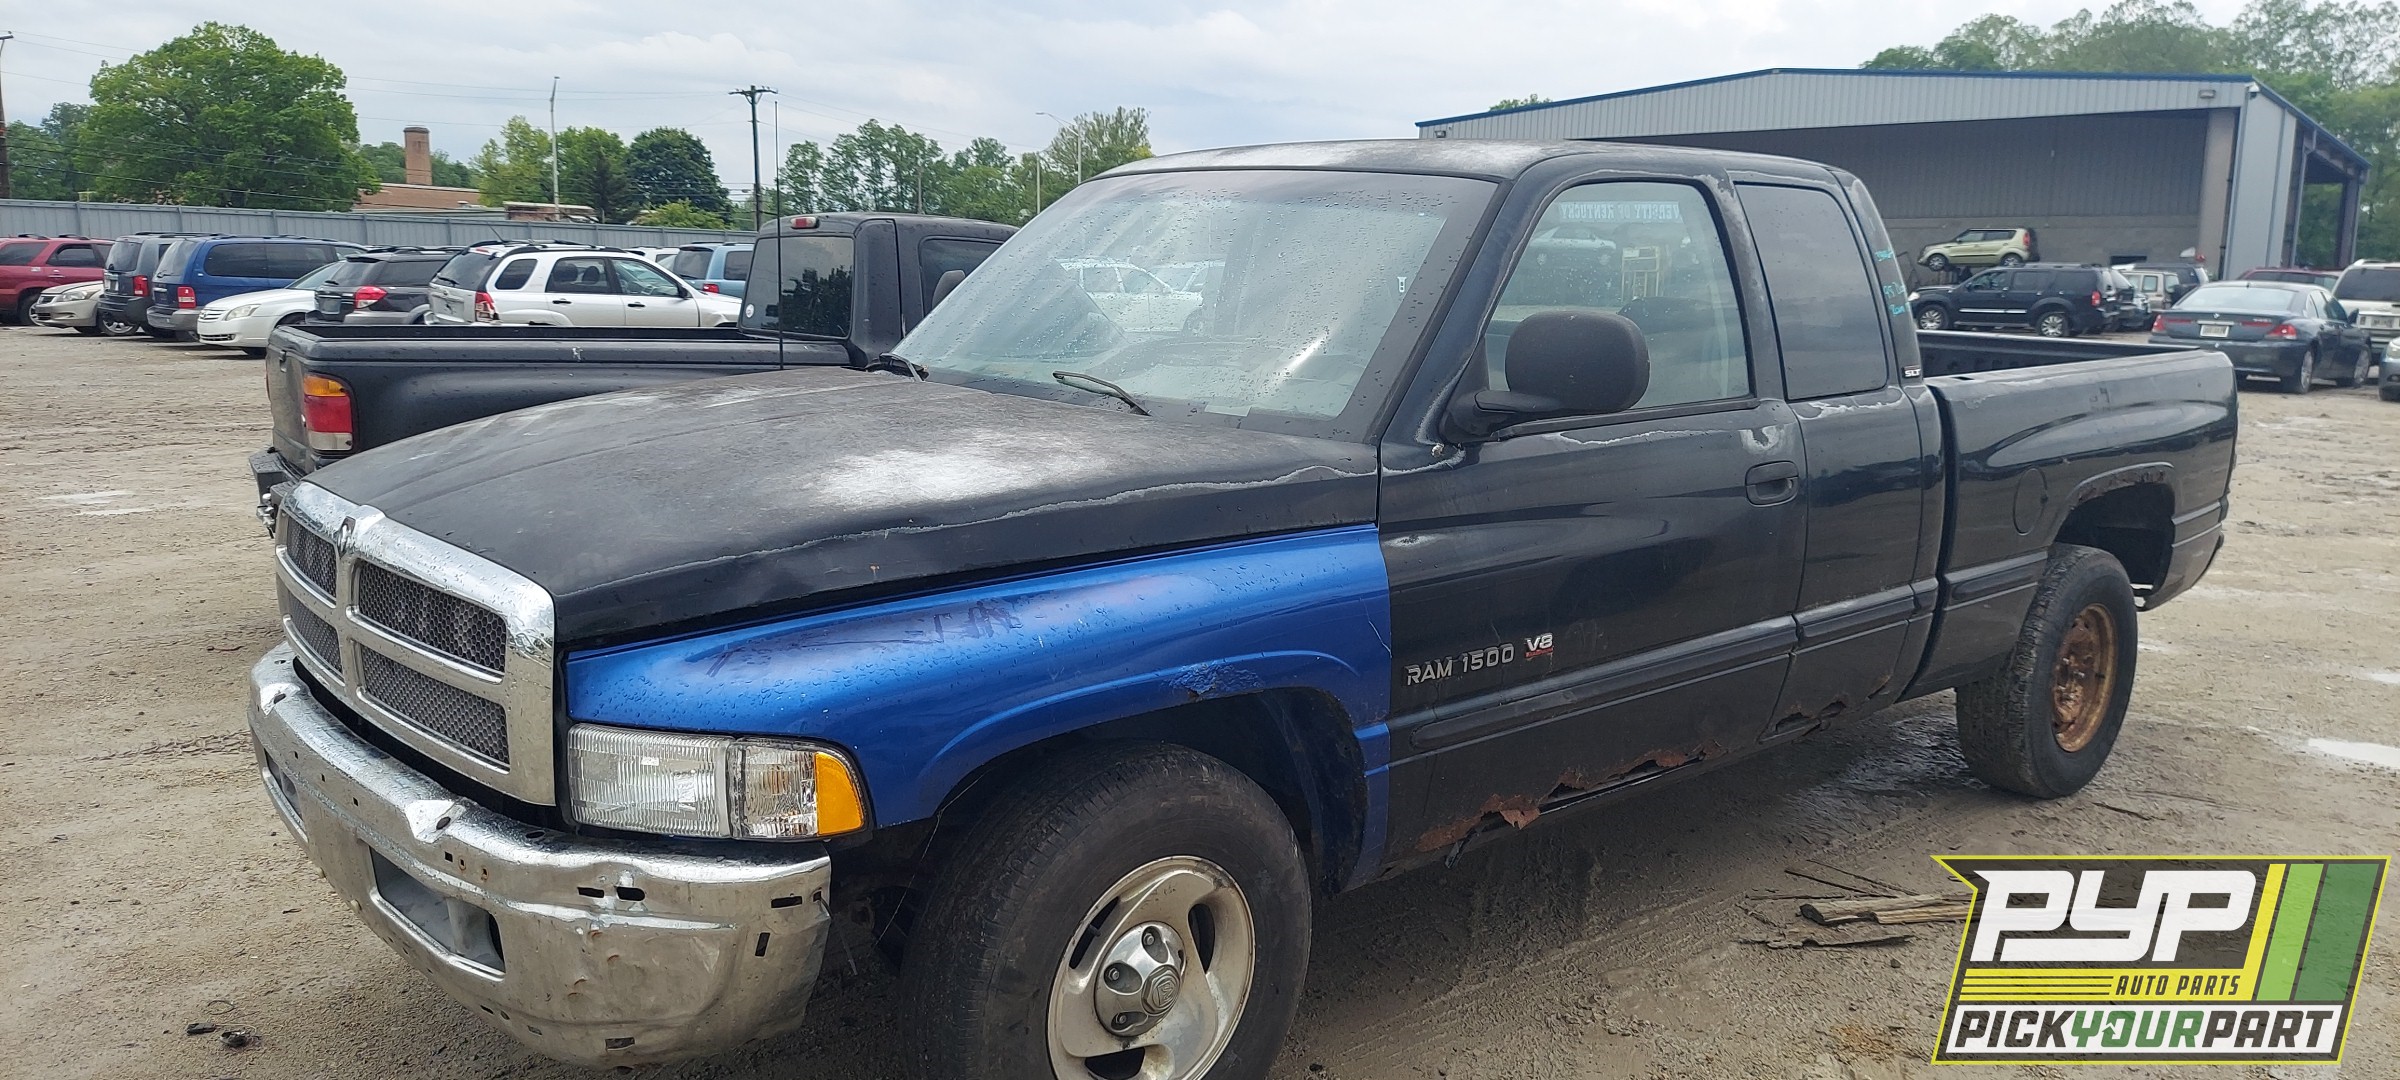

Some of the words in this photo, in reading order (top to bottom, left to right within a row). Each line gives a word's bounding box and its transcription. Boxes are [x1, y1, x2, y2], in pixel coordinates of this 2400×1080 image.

[1904, 368, 1921, 378] SLT
[1405, 656, 1453, 686] RAM
[1461, 643, 1515, 673] 1500
[1524, 633, 1553, 652] V8
